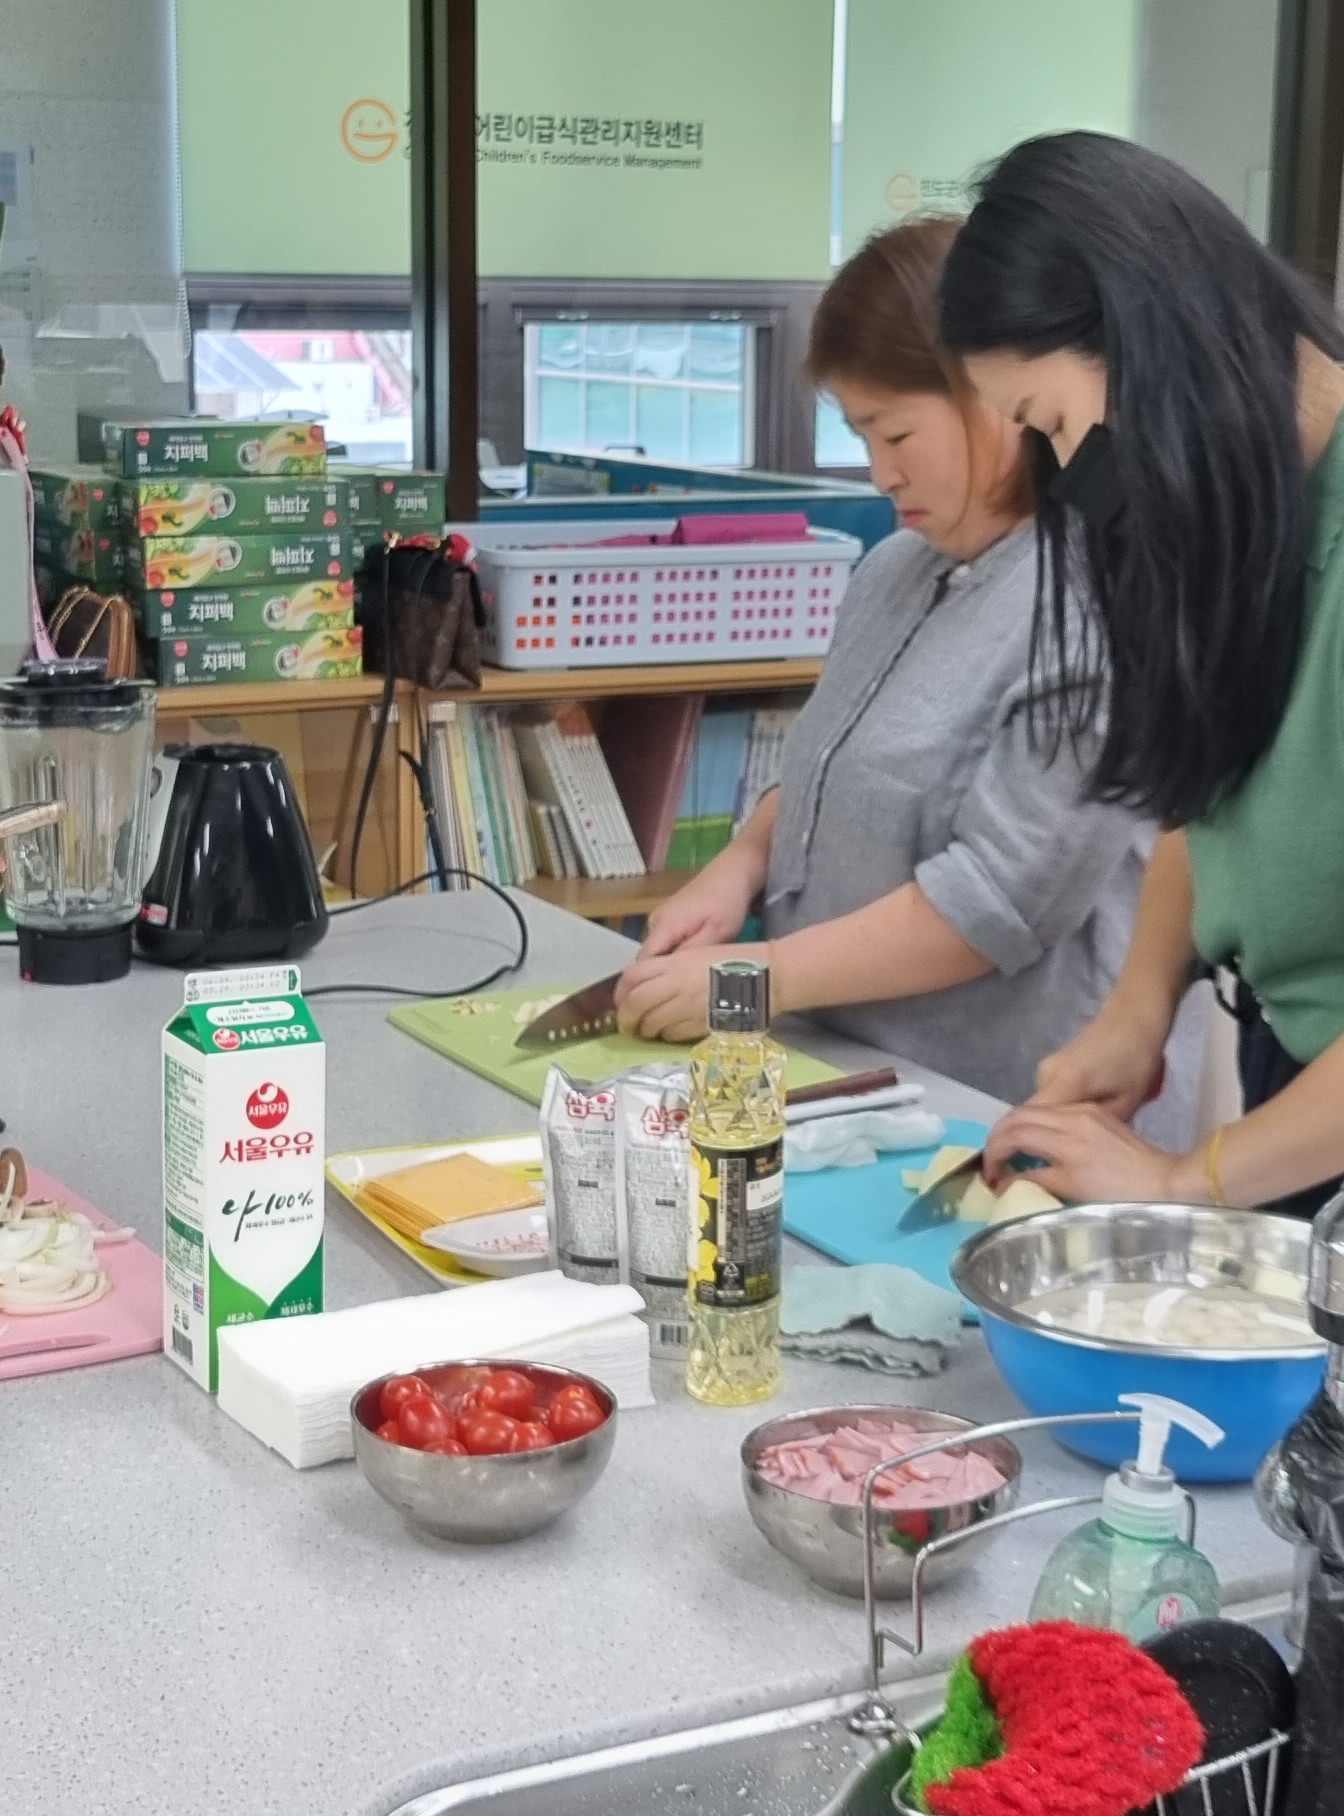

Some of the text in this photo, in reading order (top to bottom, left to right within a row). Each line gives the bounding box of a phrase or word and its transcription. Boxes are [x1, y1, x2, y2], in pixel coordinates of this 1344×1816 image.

[542, 151, 621, 167] Foodservice
[622, 154, 702, 169] Management
[164, 443, 209, 463] 지퍼백
[188, 602, 234, 622] 지퍼백
[202, 651, 246, 671] 지퍼백
[241, 1023, 310, 1046] 서울우유
[248, 1102, 289, 1118] 서울우유
[219, 1131, 314, 1164] 서울우유
